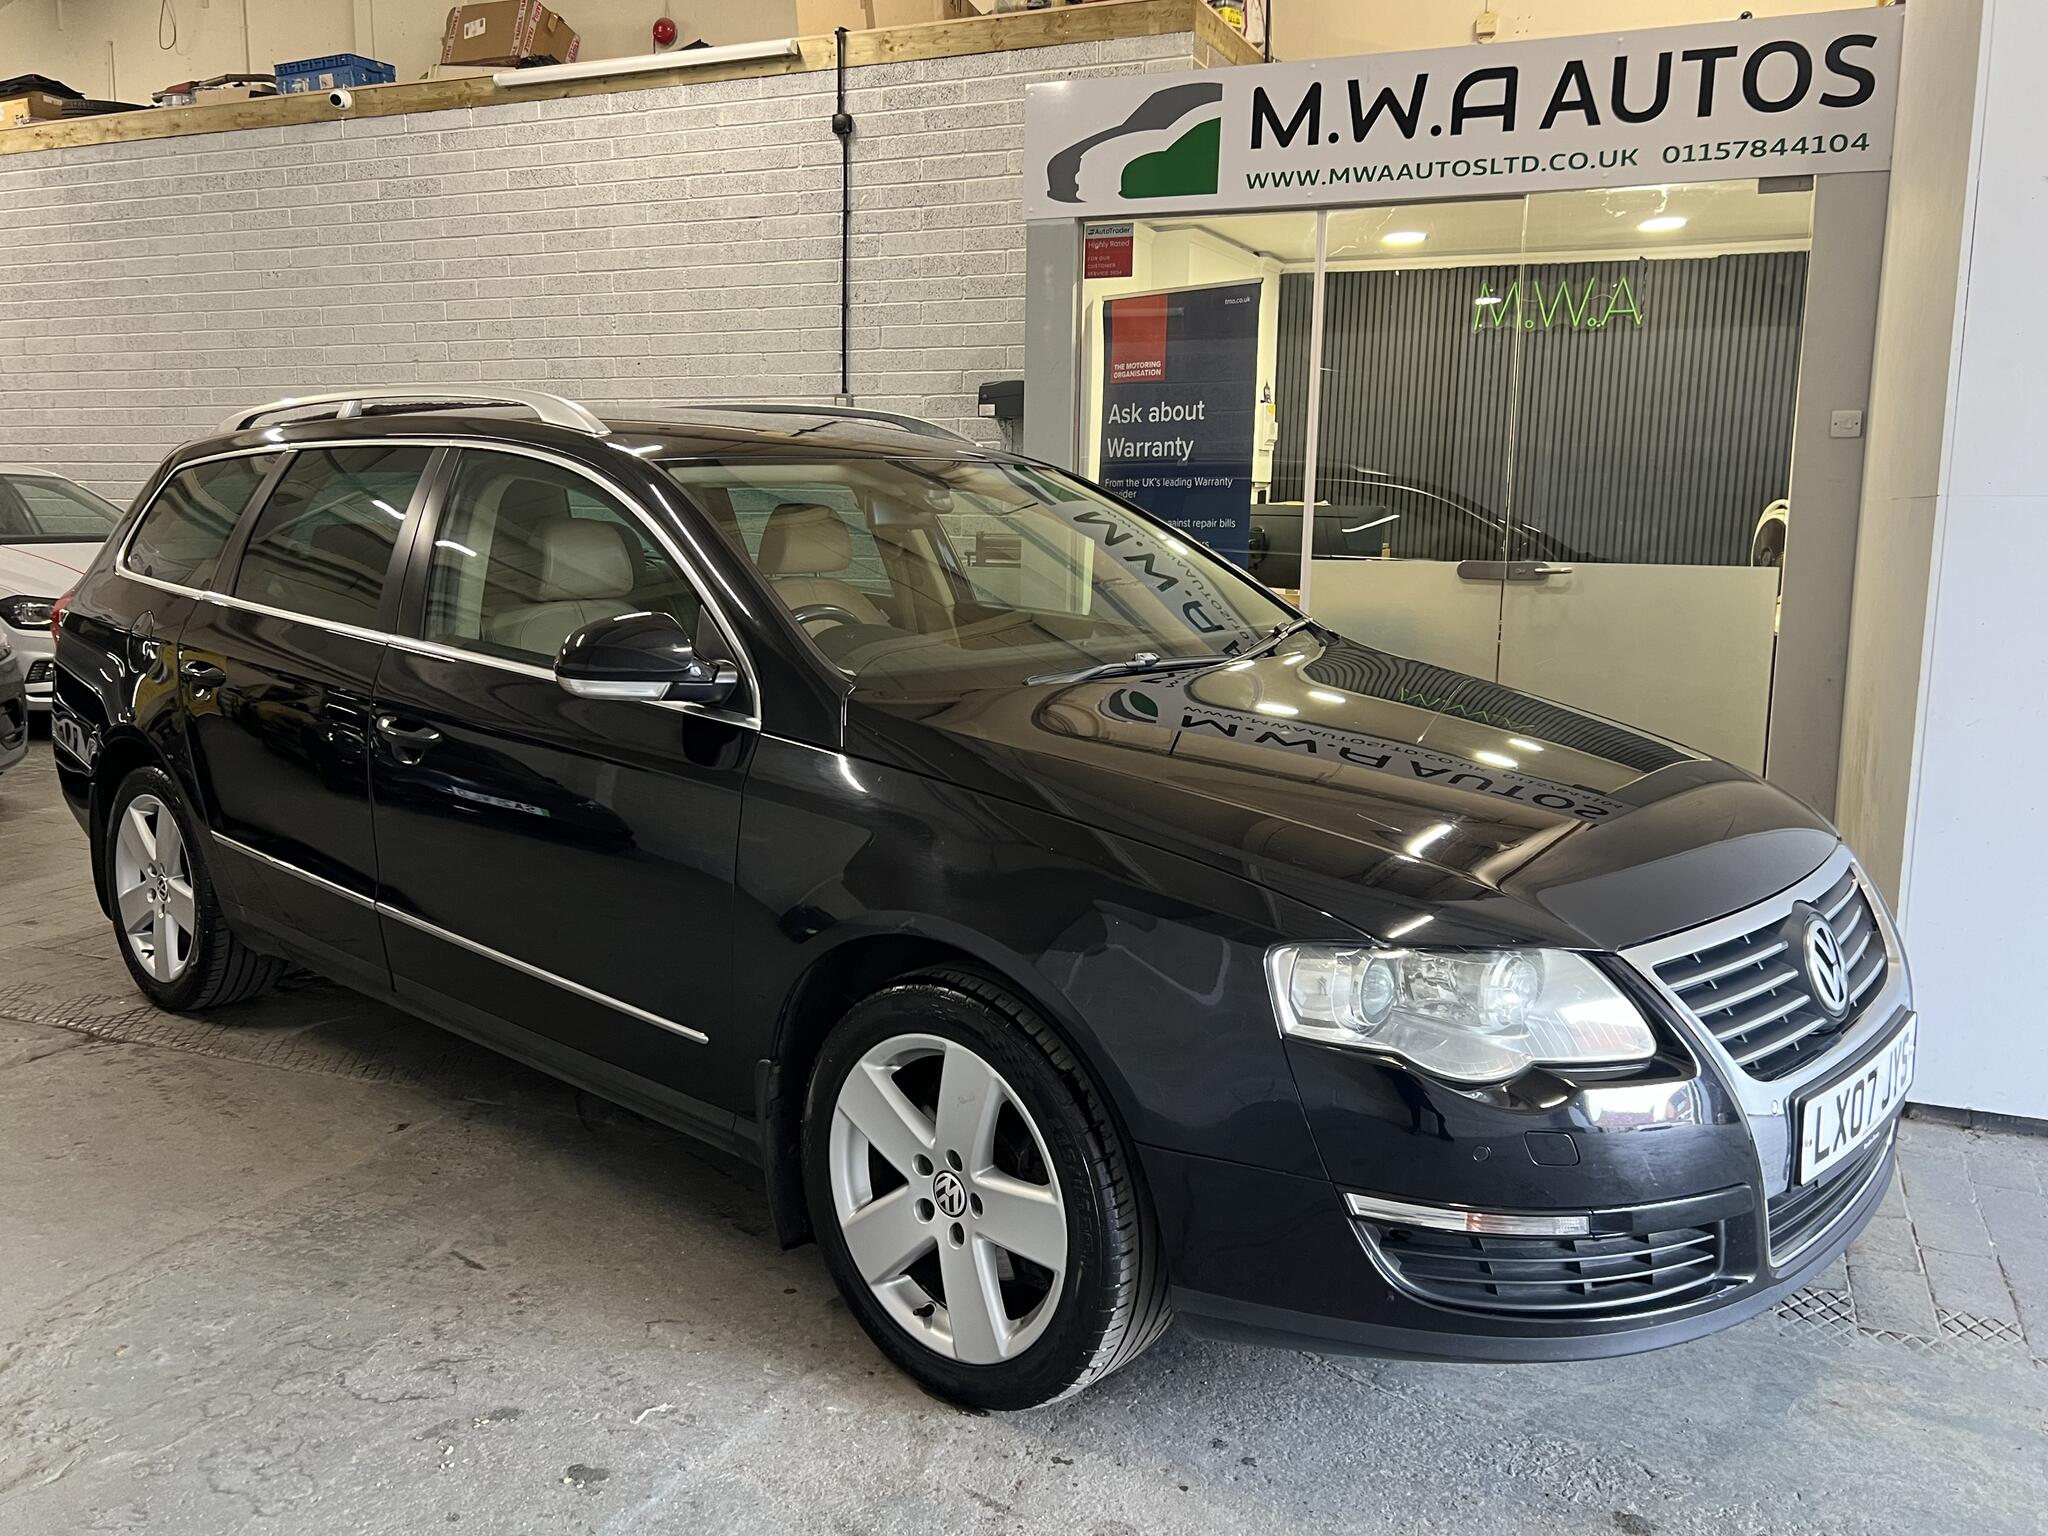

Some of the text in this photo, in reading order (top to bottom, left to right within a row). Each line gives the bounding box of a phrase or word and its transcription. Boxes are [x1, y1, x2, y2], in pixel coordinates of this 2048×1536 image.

[1251, 34, 1878, 149] M.W.A AUTOS
[1246, 133, 1870, 189] WWW.MWAAUTOSLTD.CO.UK 01157844104
[1088, 241, 1109, 249] Highly
[1473, 277, 1642, 332] M.W.A
[1113, 368, 1161, 379] ORGANISATION
[1114, 360, 1161, 371] THE MOTORING
[1108, 400, 1205, 424] Ask about
[1107, 436, 1194, 462] Warranty
[1104, 476, 1233, 489] From the UK's leading Warranty
[1192, 518, 1218, 530] repair
[1219, 517, 1236, 528] bills
[1814, 1031, 1910, 1164] LX07 JYS
